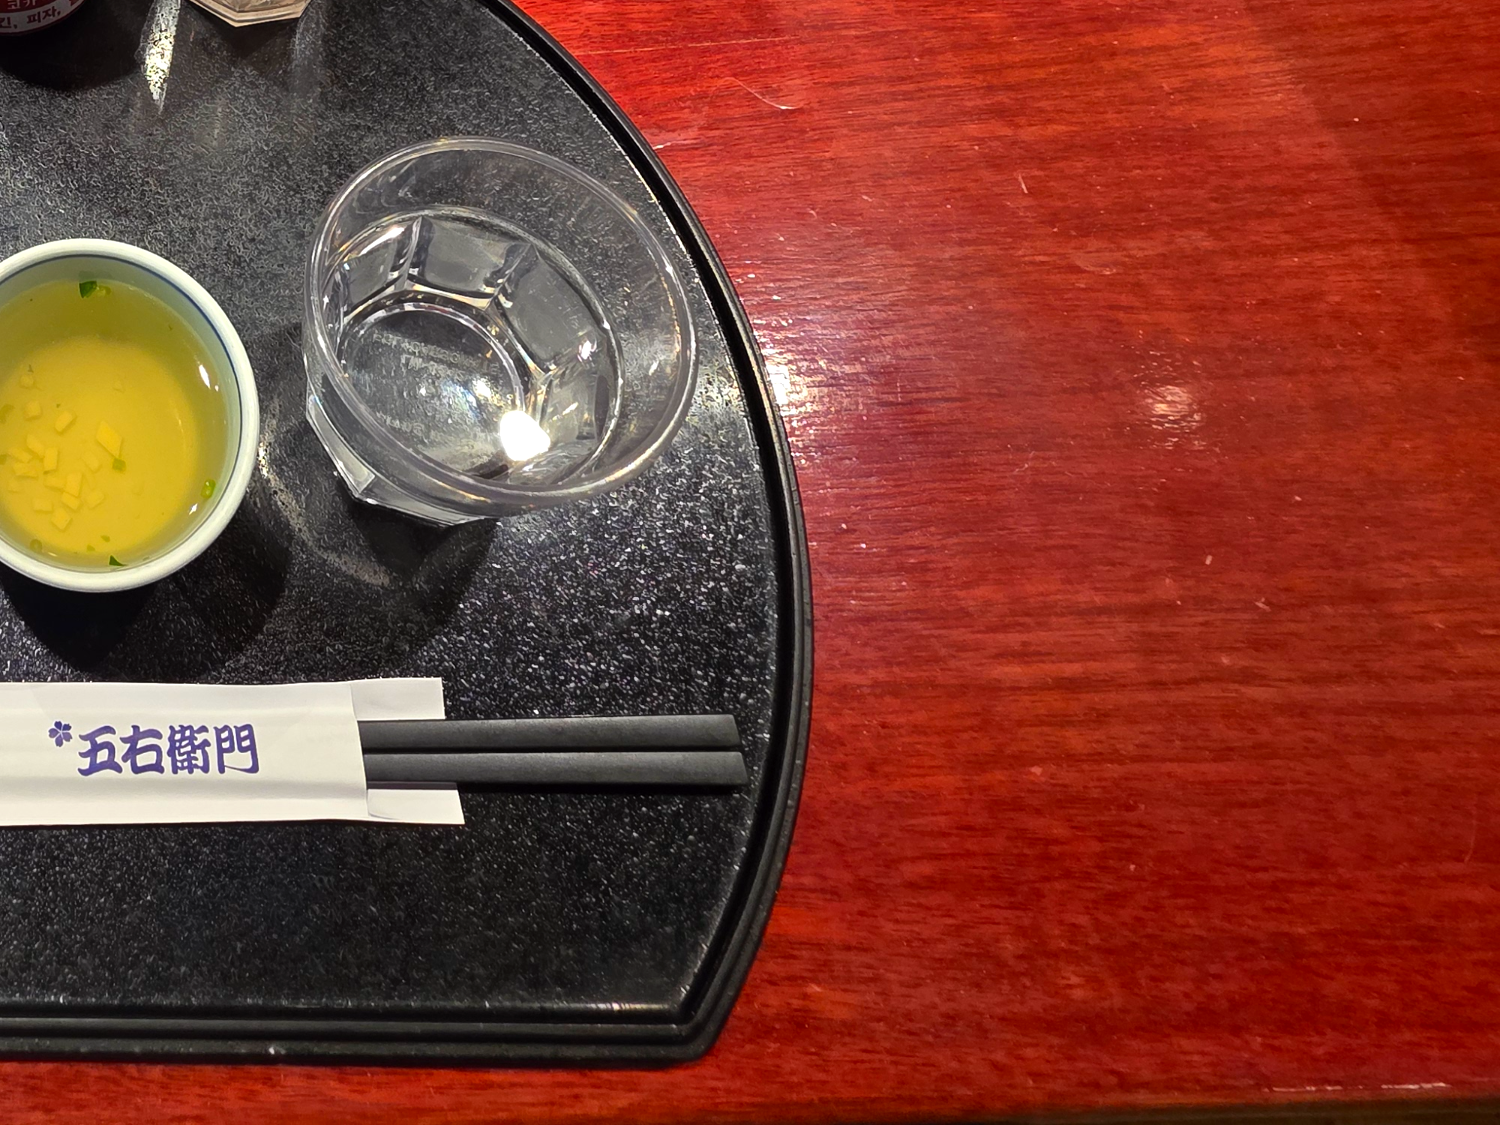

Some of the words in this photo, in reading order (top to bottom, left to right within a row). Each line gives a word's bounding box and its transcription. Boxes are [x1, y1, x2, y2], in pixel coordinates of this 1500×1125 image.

[27, 6, 61, 24] 피자,
[77, 723, 260, 777] 五右衛門
